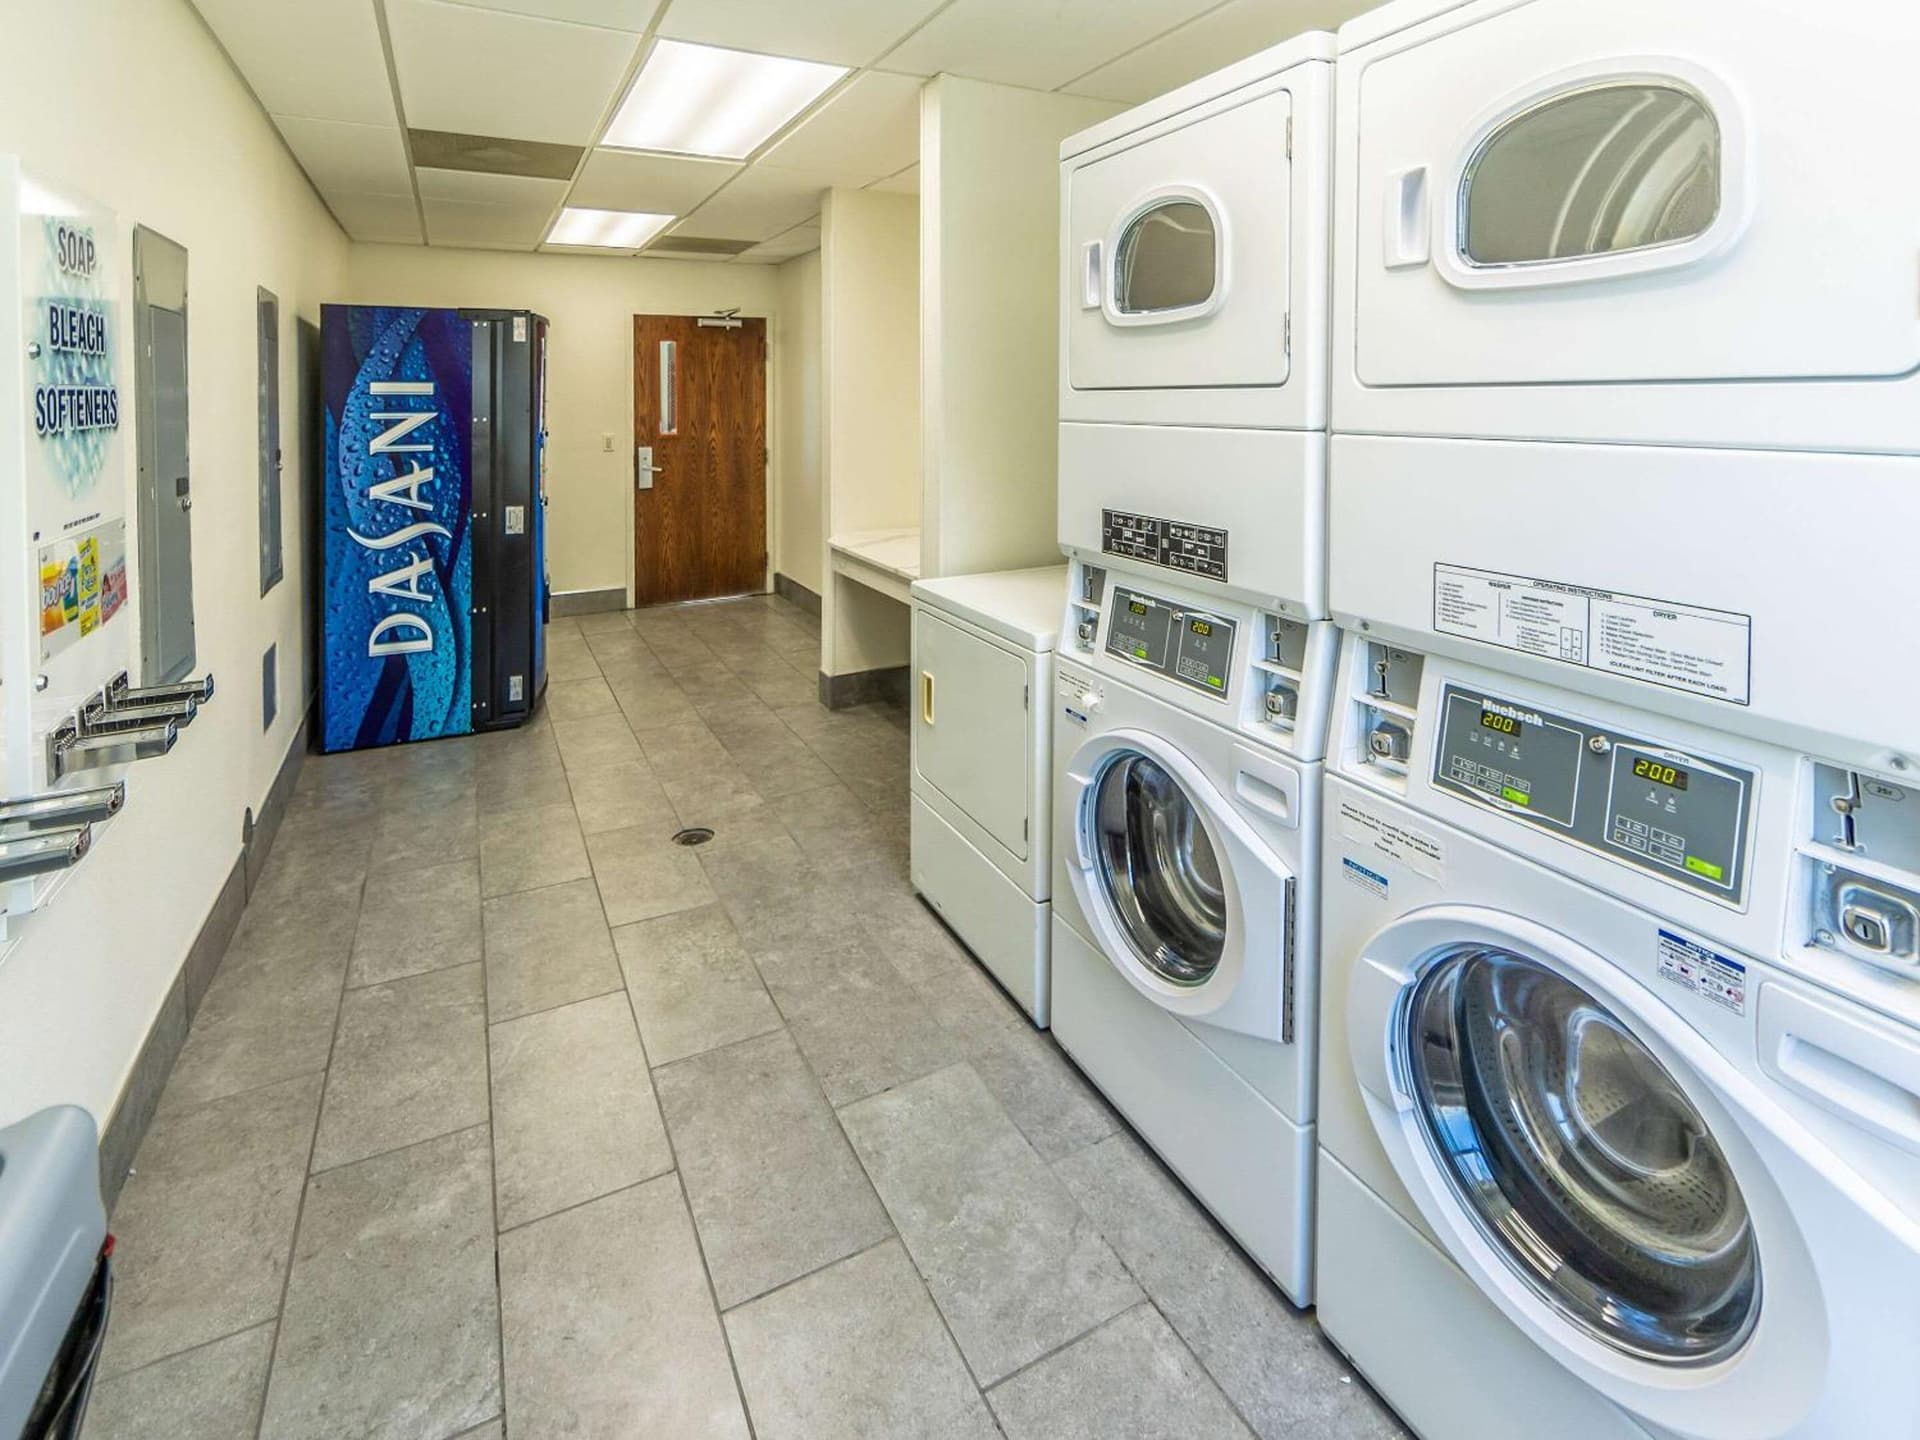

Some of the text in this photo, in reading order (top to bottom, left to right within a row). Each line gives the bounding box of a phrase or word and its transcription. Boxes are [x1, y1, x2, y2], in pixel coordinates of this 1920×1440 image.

[57, 226, 96, 275] SOAP
[50, 305, 105, 352] BLEACH
[36, 387, 118, 432] SOFTENERS
[346, 381, 453, 658] DASANI
[1533, 580, 1613, 600] OPERATING INSTRUCTIONS
[1192, 622, 1209, 635] 200
[1483, 699, 1544, 727] Huebsch
[1483, 712, 1513, 732] 200
[1635, 760, 1676, 784] 200
